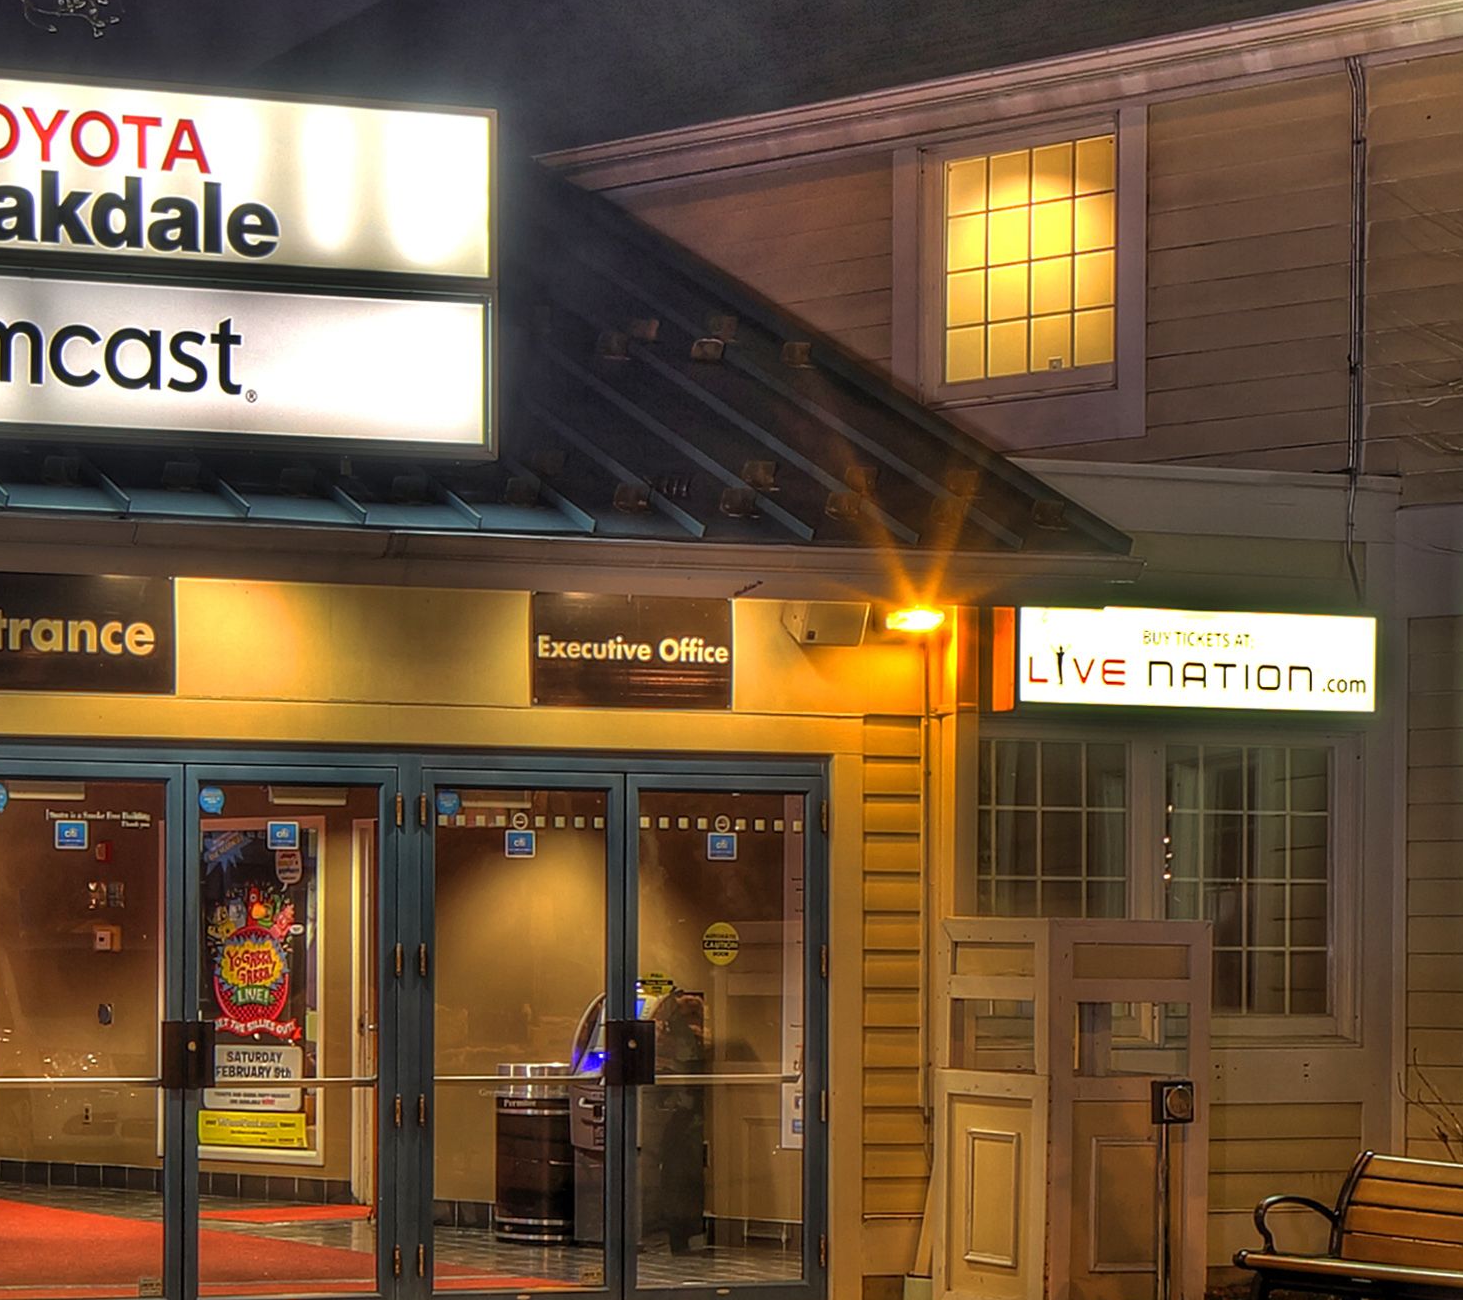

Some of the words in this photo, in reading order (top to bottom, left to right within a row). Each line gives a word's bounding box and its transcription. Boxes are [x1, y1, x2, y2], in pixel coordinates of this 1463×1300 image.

[1143, 630, 1171, 646] BUY
[1174, 631, 1230, 648] TICKETS
[537, 634, 651, 661] Executive
[659, 636, 729, 664] Office
[237, 987, 270, 1003] LIVE!
[226, 1051, 283, 1063] SATURDAY
[215, 1065, 272, 1078] FEBRUARY
[274, 1066, 292, 1079] 9th
